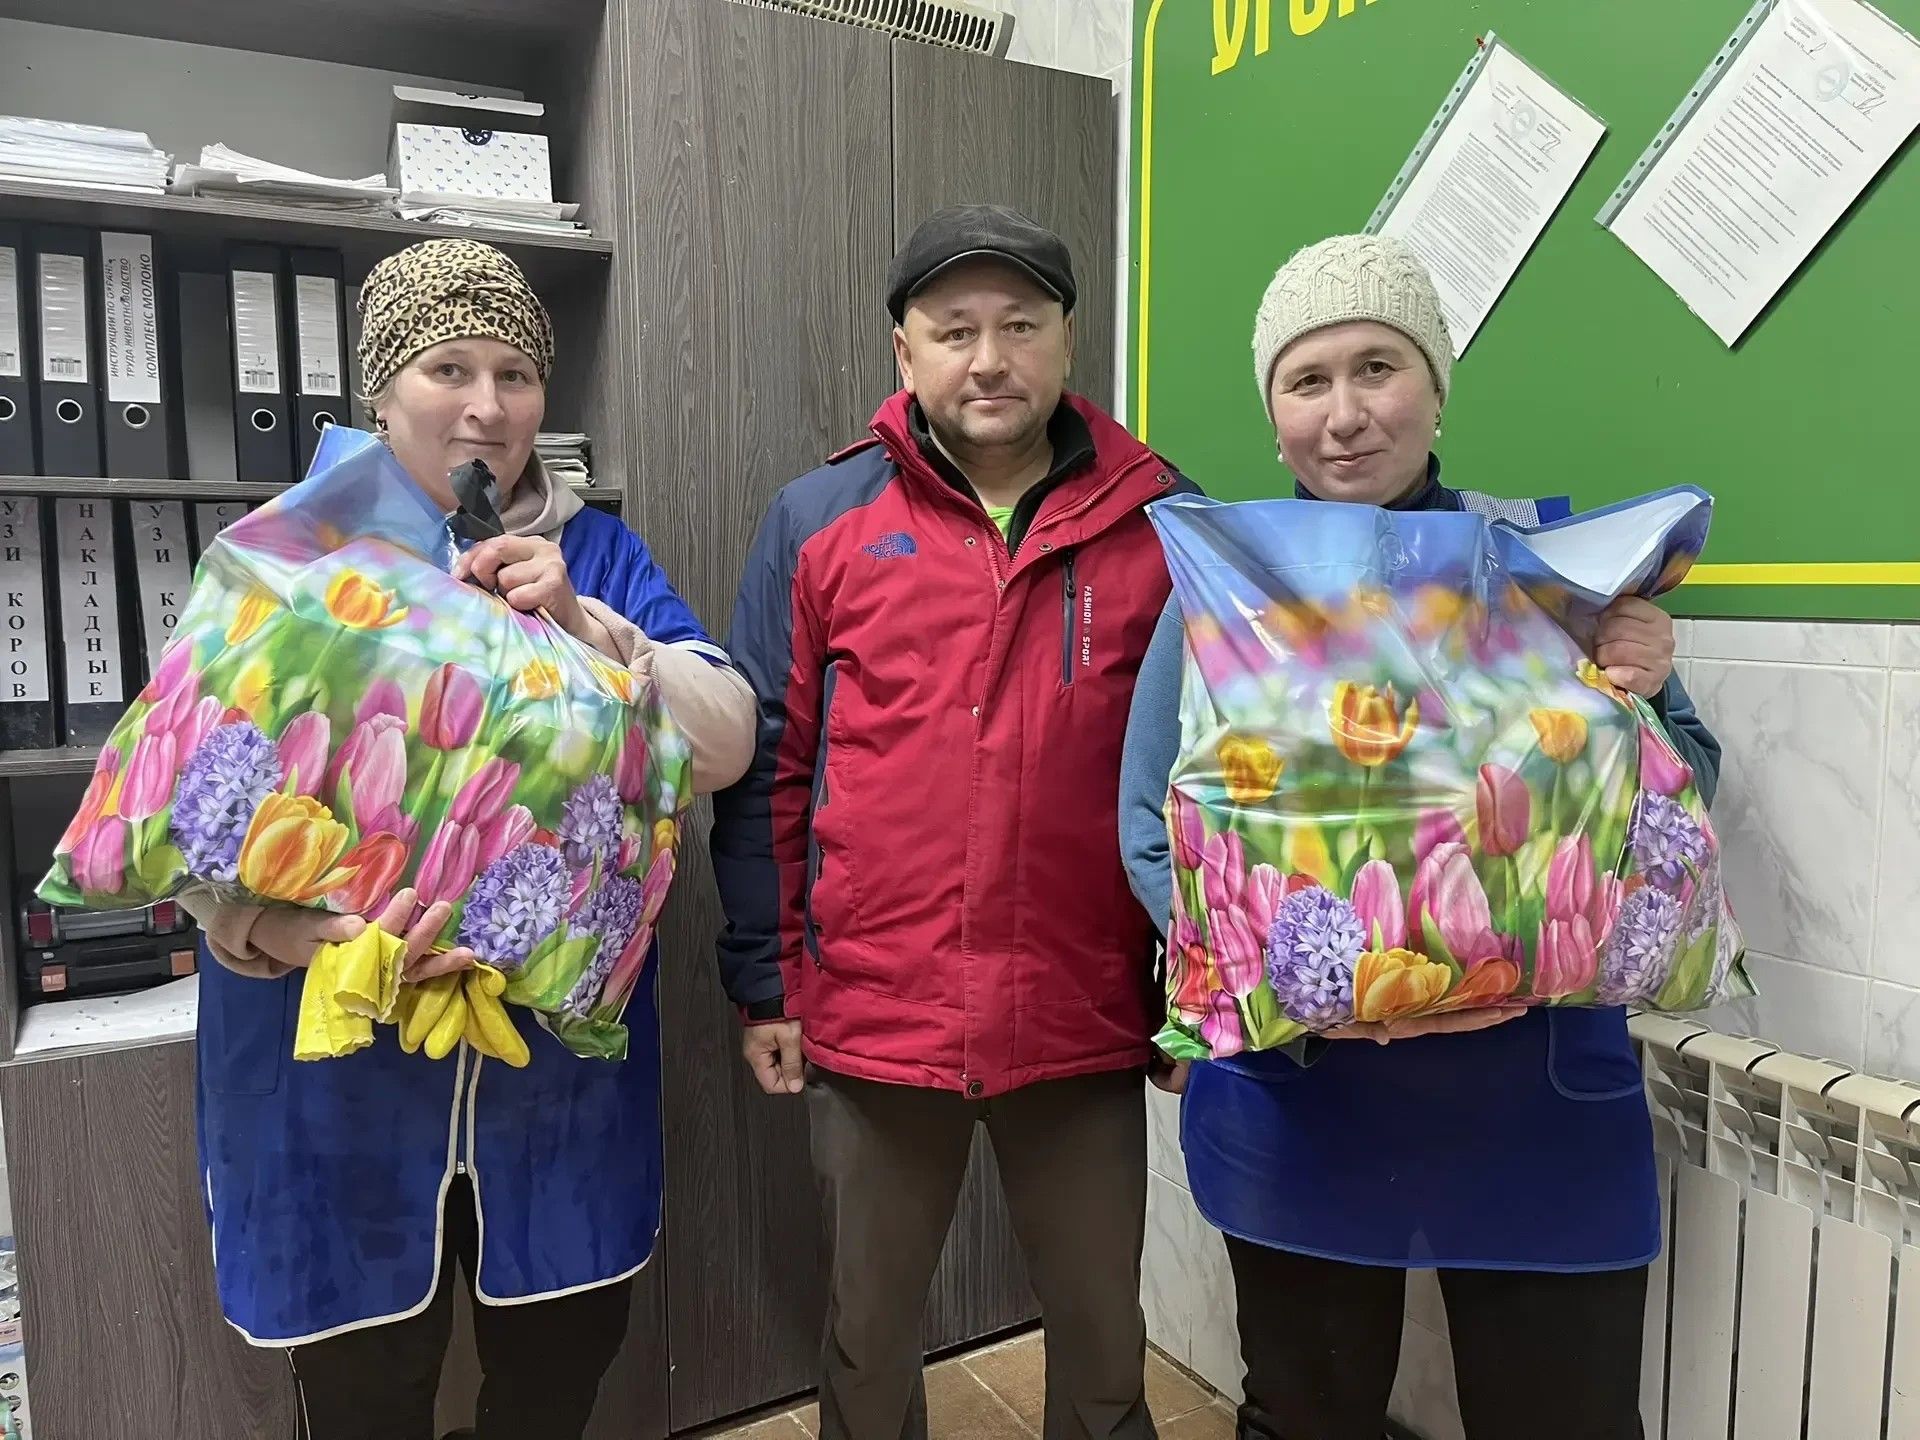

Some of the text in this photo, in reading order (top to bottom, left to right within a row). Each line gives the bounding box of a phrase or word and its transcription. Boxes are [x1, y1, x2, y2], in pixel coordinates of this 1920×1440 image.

[105, 300, 116, 315] ПО
[140, 253, 157, 379] КОМПЛЕКС МОЛОКО
[124, 349, 136, 378] ТРУДА
[150, 504, 171, 563] УЗИ
[4, 501, 27, 698] УЗИ КОРОВ
[79, 503, 109, 697] НАКЛАДНЫЕ
[1082, 585, 1092, 667] FASHION SPORT
